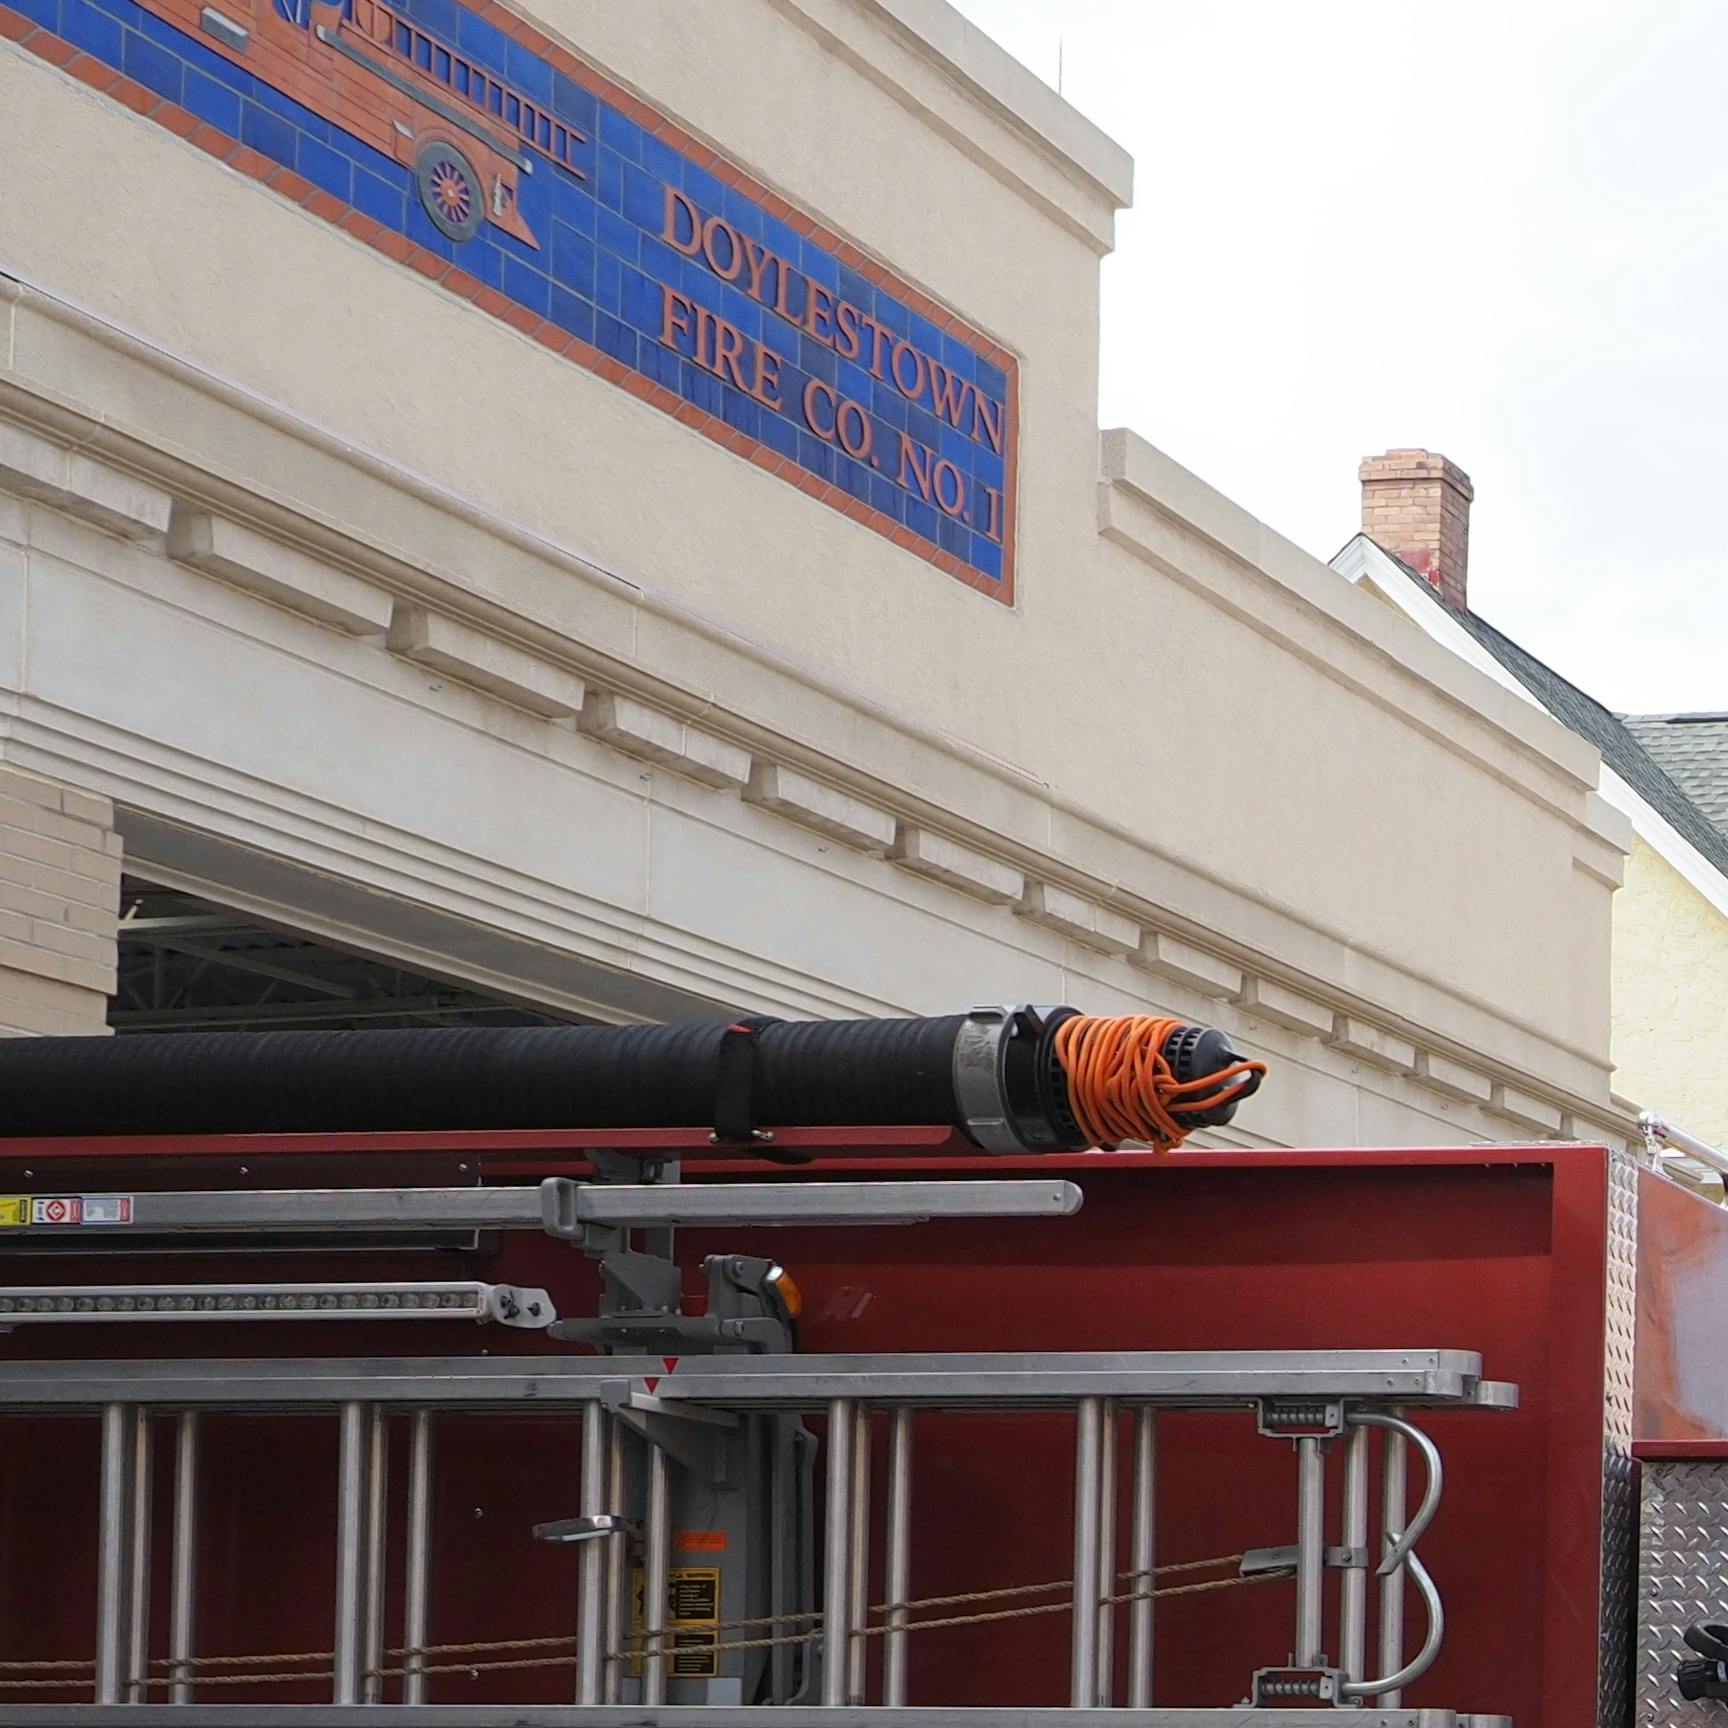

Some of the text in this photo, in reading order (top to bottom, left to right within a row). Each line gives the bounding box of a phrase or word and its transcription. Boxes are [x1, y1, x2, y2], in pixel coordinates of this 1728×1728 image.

[659, 282, 783, 412] FIRE
[803, 378, 879, 468] CO.
[897, 432, 970, 522] NO.
[661, 182, 1002, 454] DOYLESTOWN
